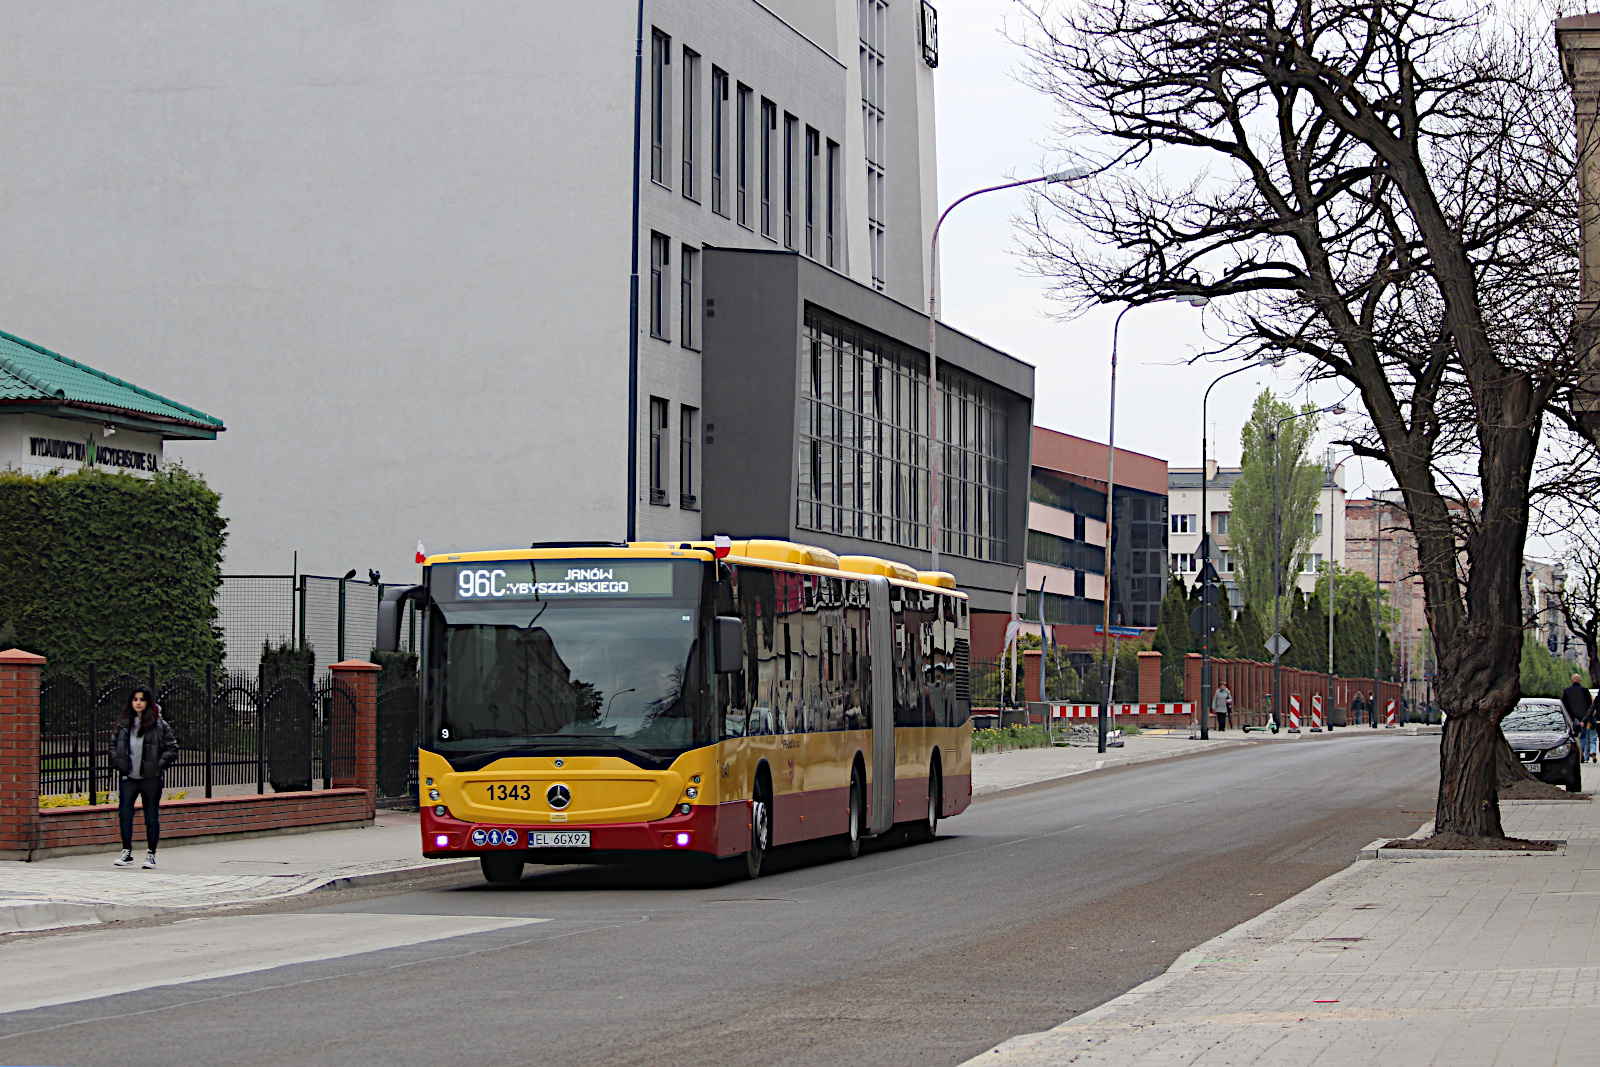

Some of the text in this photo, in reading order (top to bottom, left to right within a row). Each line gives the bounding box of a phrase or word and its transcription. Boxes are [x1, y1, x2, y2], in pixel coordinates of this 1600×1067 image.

[565, 568, 613, 580] JANÓW
[441, 729, 450, 738] 9
[486, 785, 531, 800] 1343
[536, 834, 549, 844] EL
[553, 833, 587, 845] 6GX92
